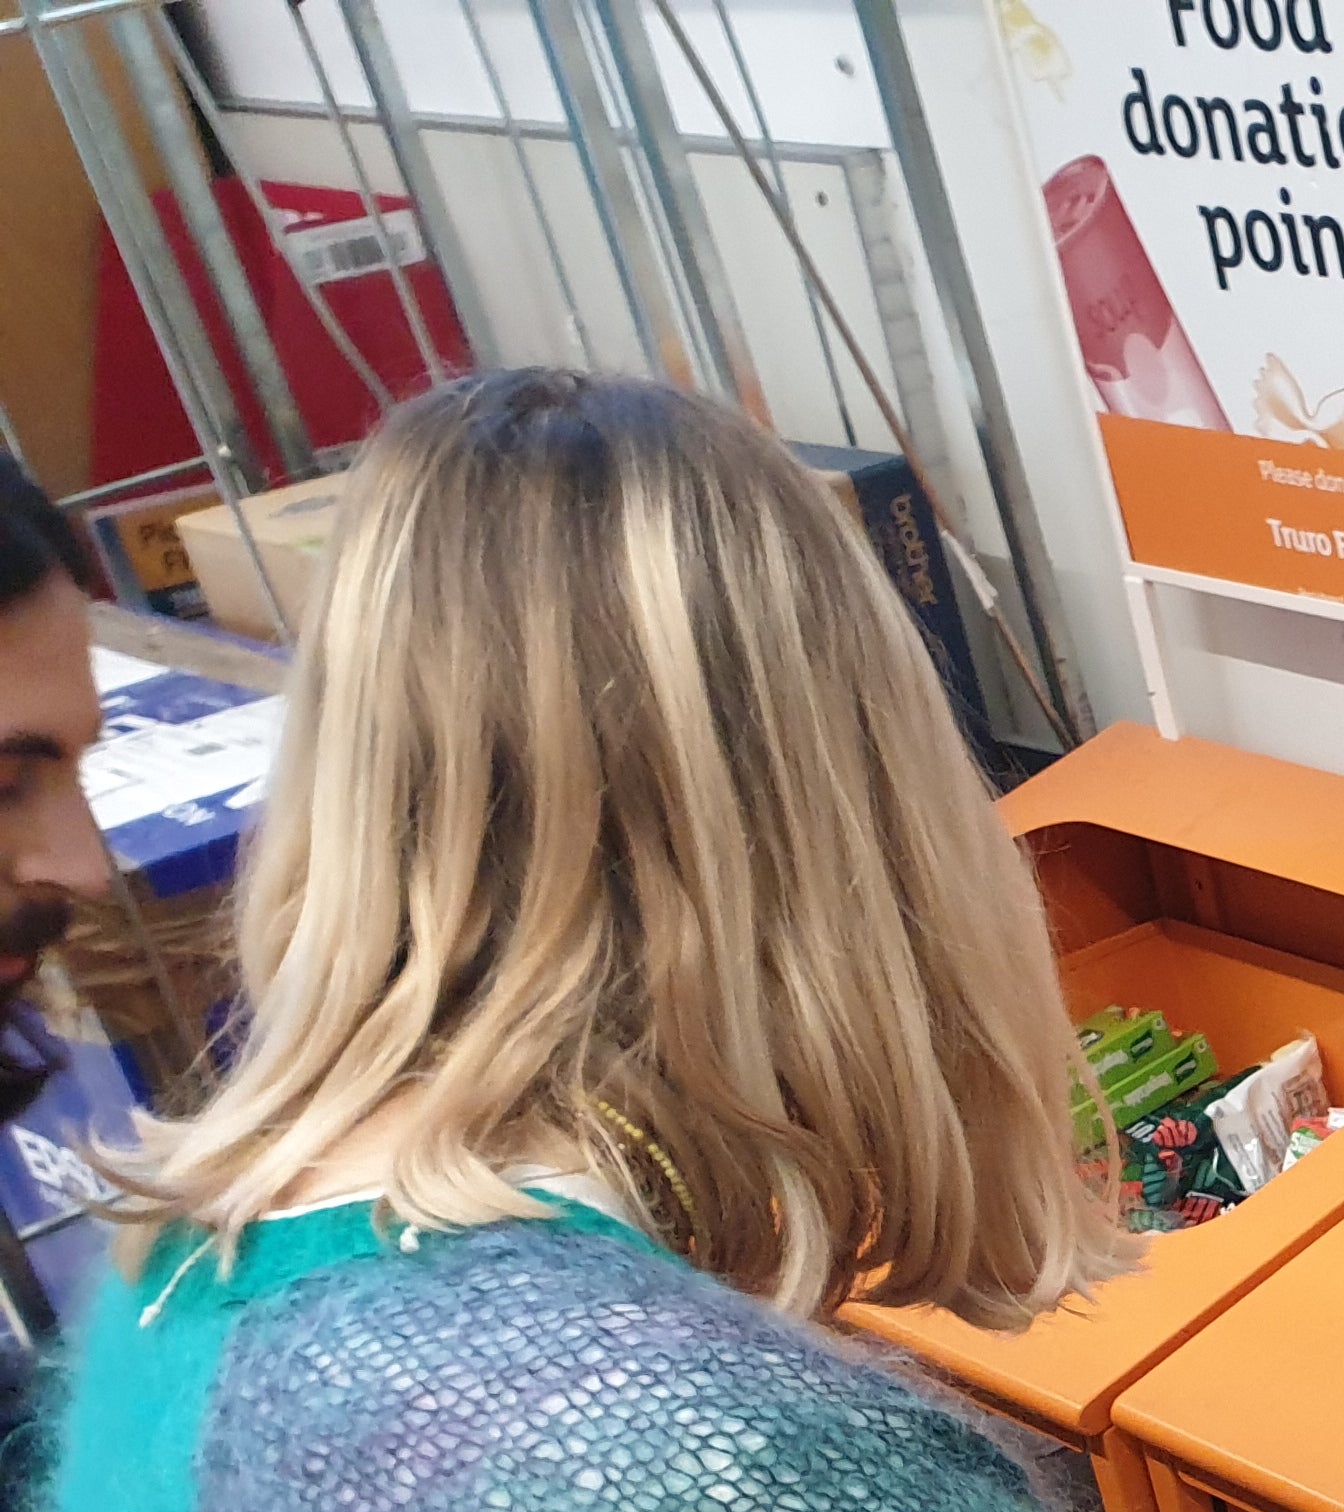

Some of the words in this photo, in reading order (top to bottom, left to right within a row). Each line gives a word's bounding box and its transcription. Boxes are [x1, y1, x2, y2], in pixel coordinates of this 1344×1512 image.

[1166, 0, 1333, 53] Food
[1257, 460, 1313, 489] Please
[1265, 518, 1332, 556] Truro
